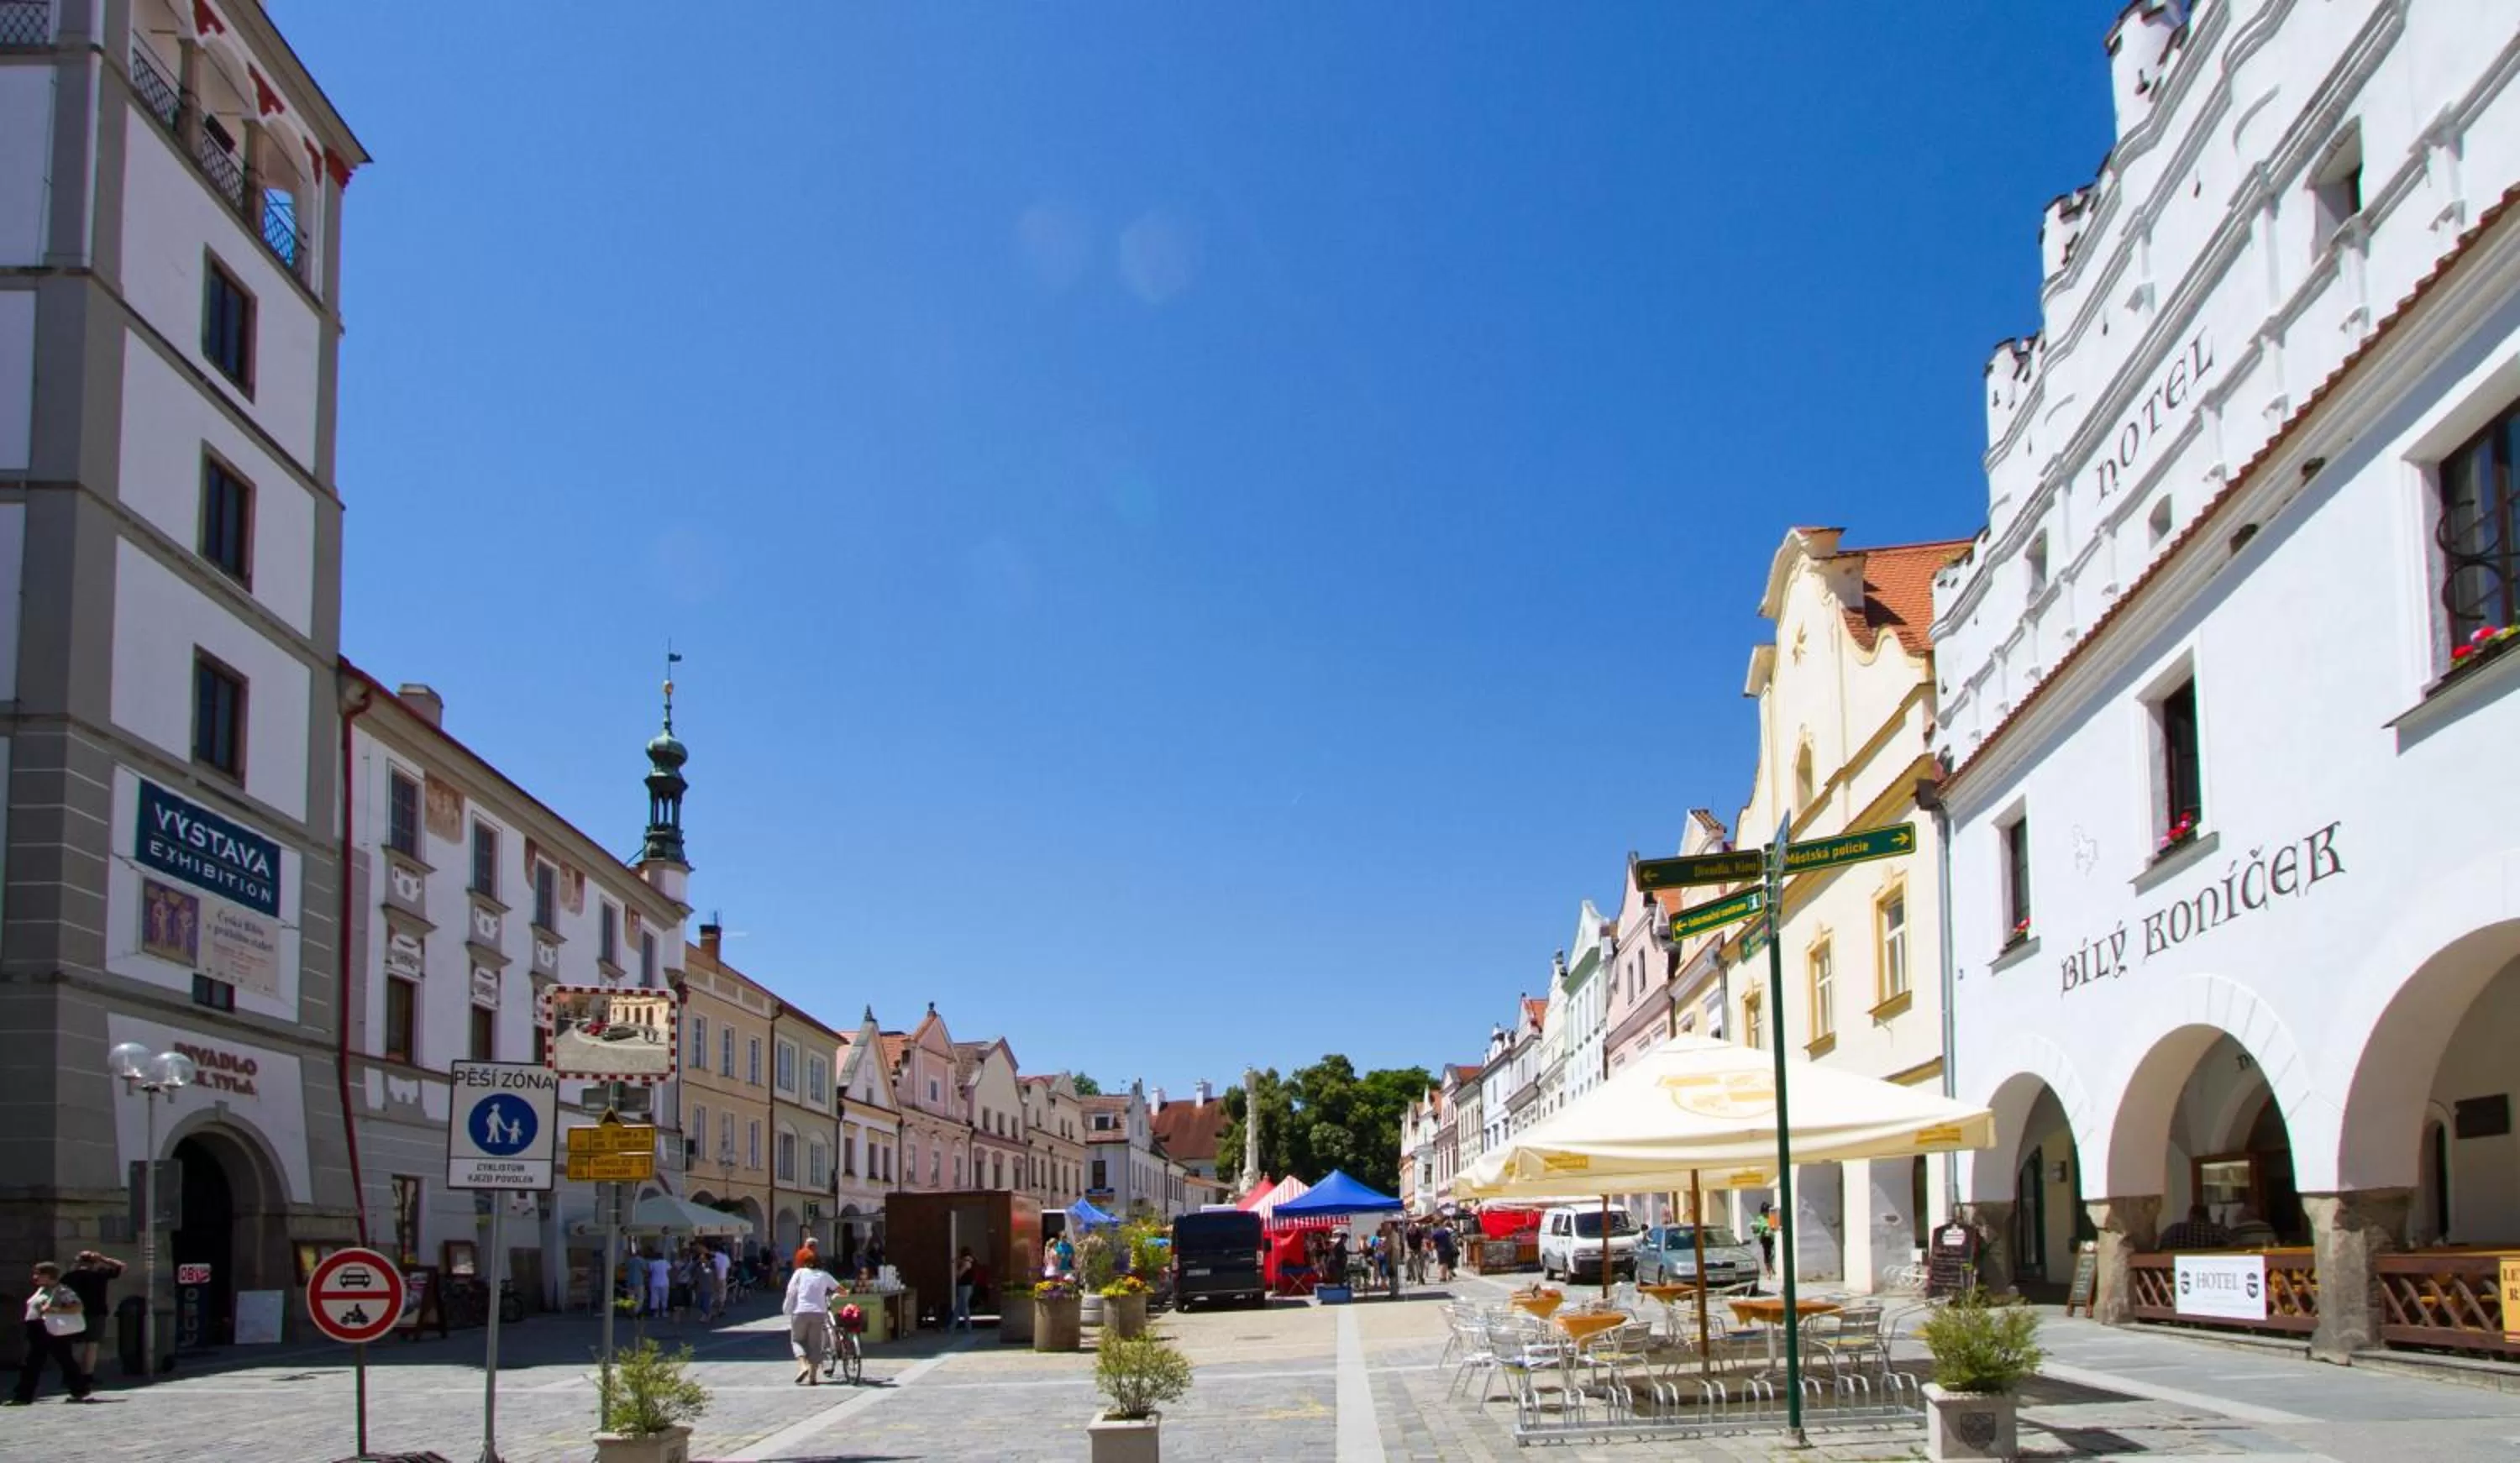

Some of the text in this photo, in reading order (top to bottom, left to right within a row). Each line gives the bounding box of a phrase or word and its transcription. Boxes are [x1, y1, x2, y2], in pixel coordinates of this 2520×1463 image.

[155, 802, 271, 878] VÝSTAVA
[1832, 842, 1869, 859] policie
[150, 839, 272, 903] EXHIBITION
[2061, 821, 2346, 999] BÍLÝ KONÍČEK
[454, 1067, 554, 1089] PĚŠÍ ZÓNA
[2196, 1272, 2239, 1290] HOTEL
